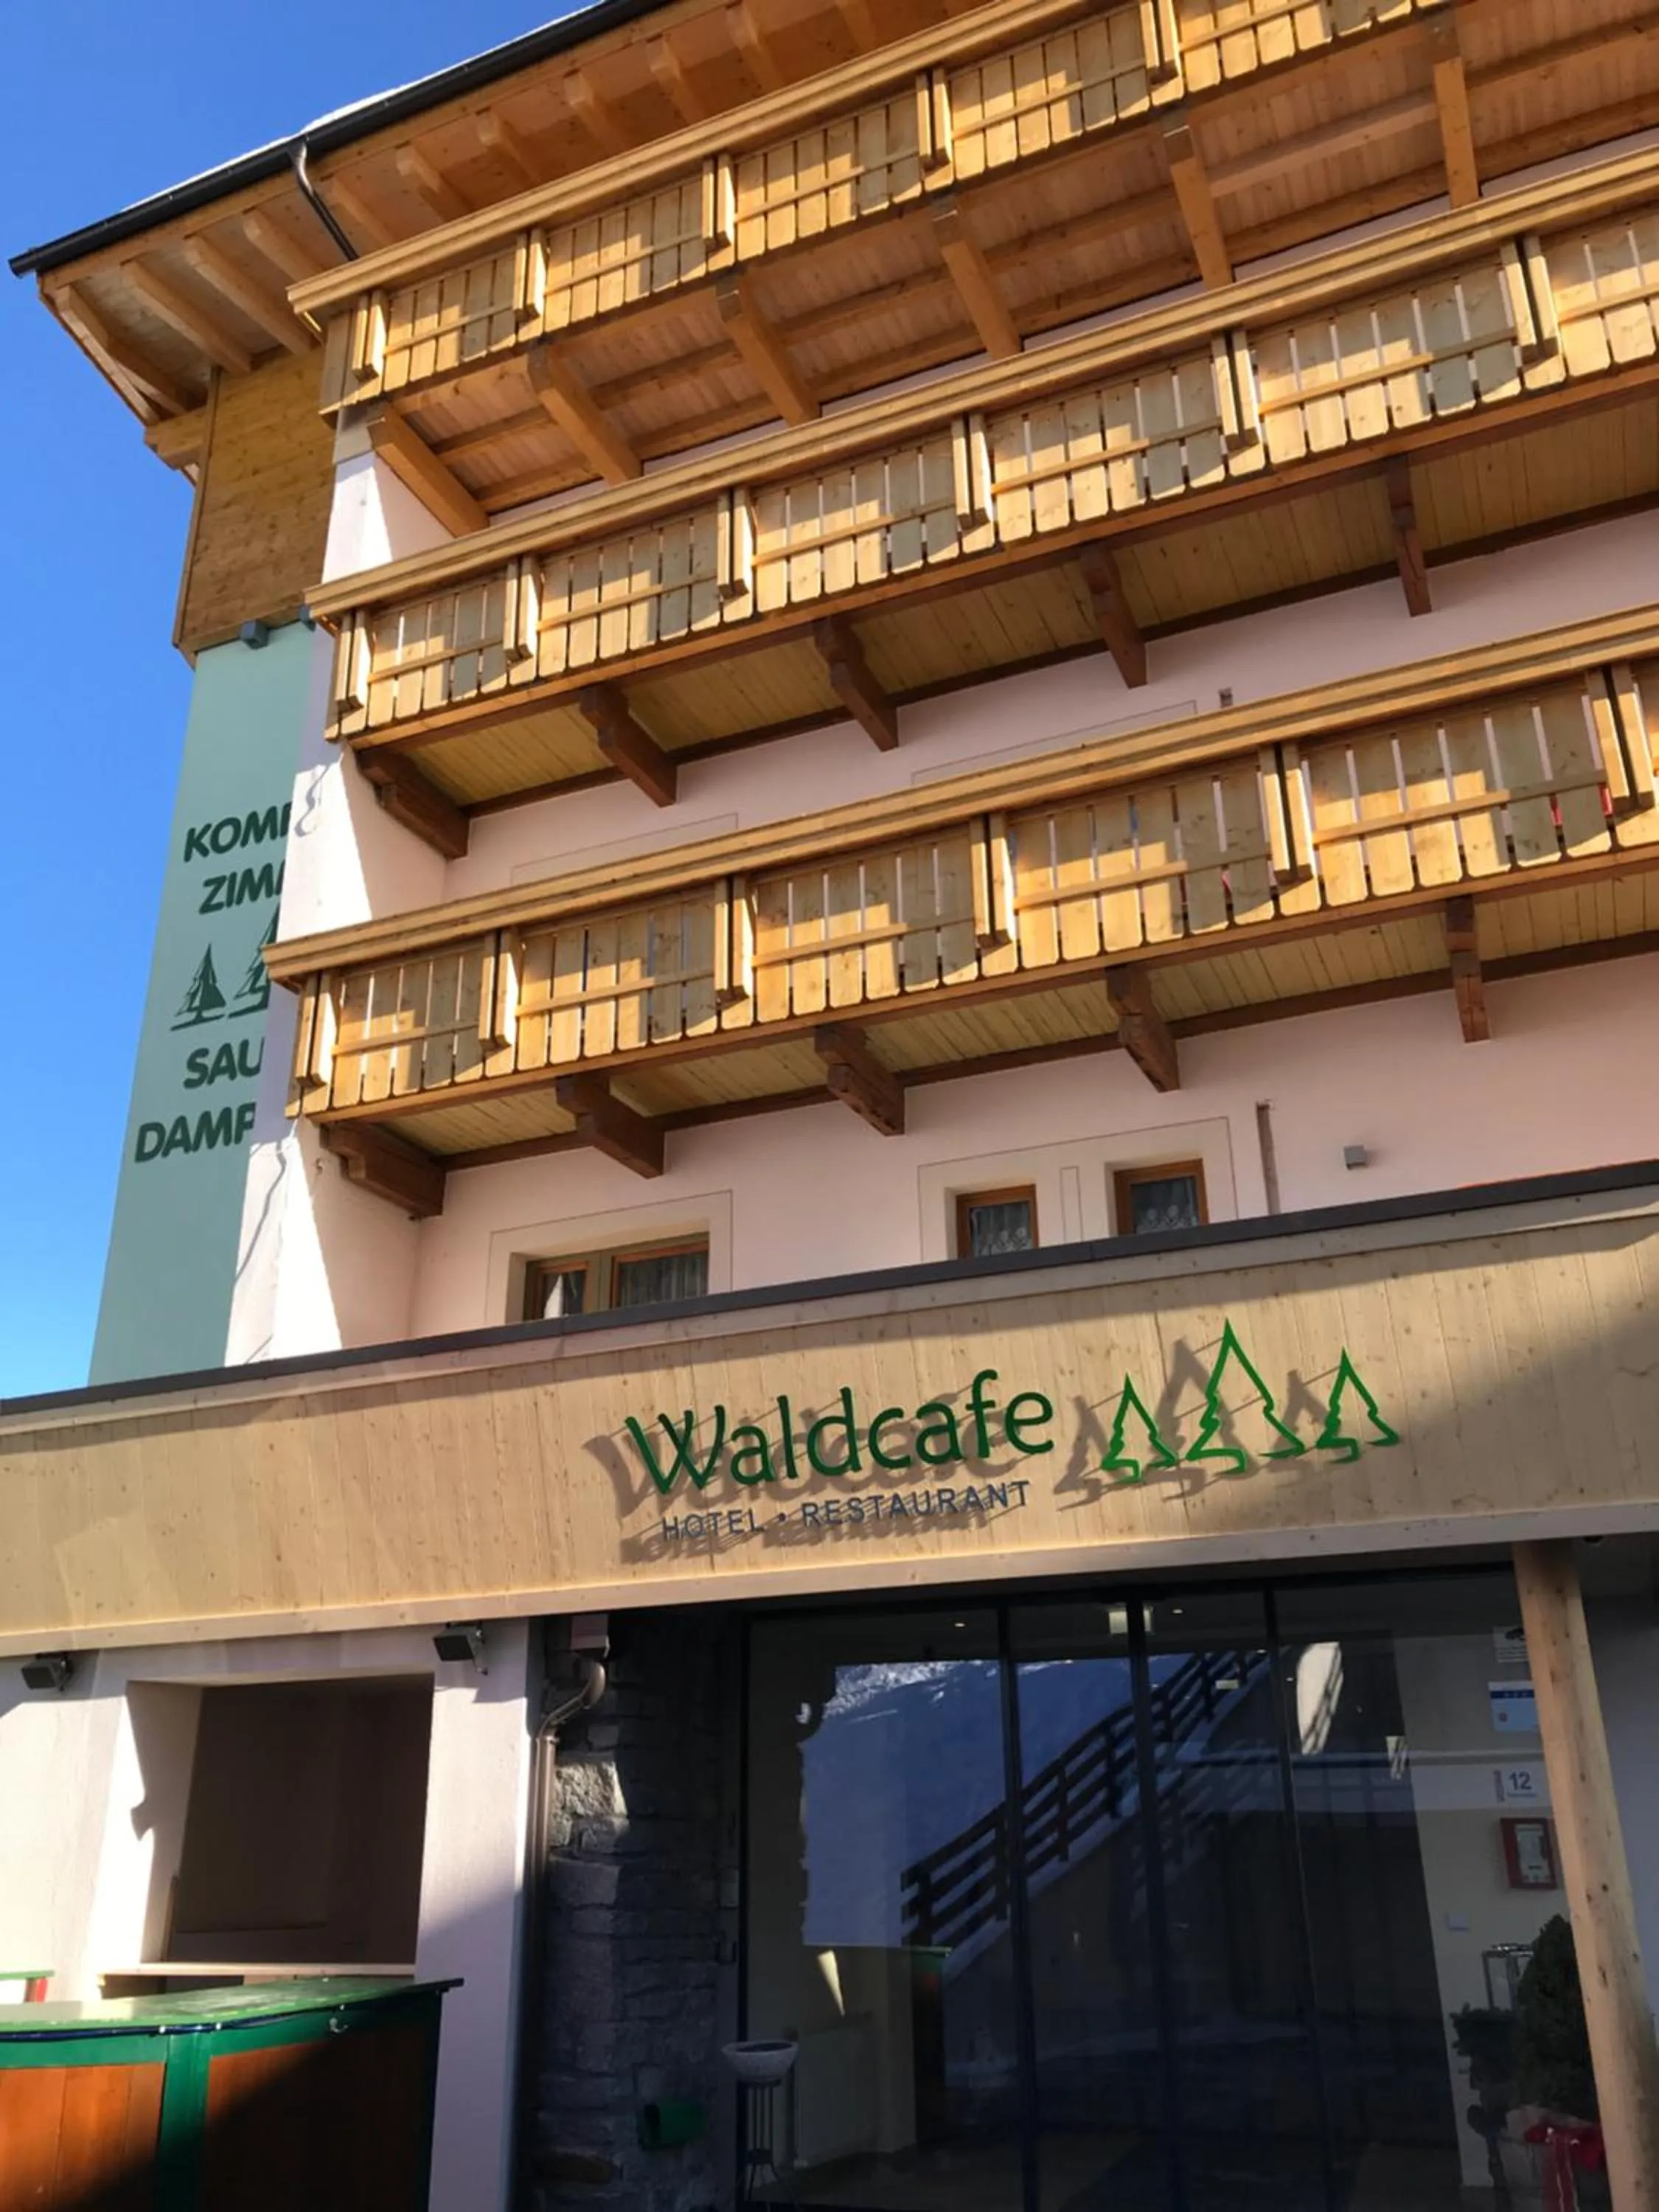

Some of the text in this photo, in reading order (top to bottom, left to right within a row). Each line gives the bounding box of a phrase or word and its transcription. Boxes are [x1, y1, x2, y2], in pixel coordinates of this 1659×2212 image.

[198, 860, 285, 915] ZIM
[183, 1036, 265, 1090] SAU
[624, 1369, 1055, 1495] Waldcafe
[663, 1480, 1031, 1542] HOTEL RESTAURANT
[1509, 1771, 1532, 1791] 12
